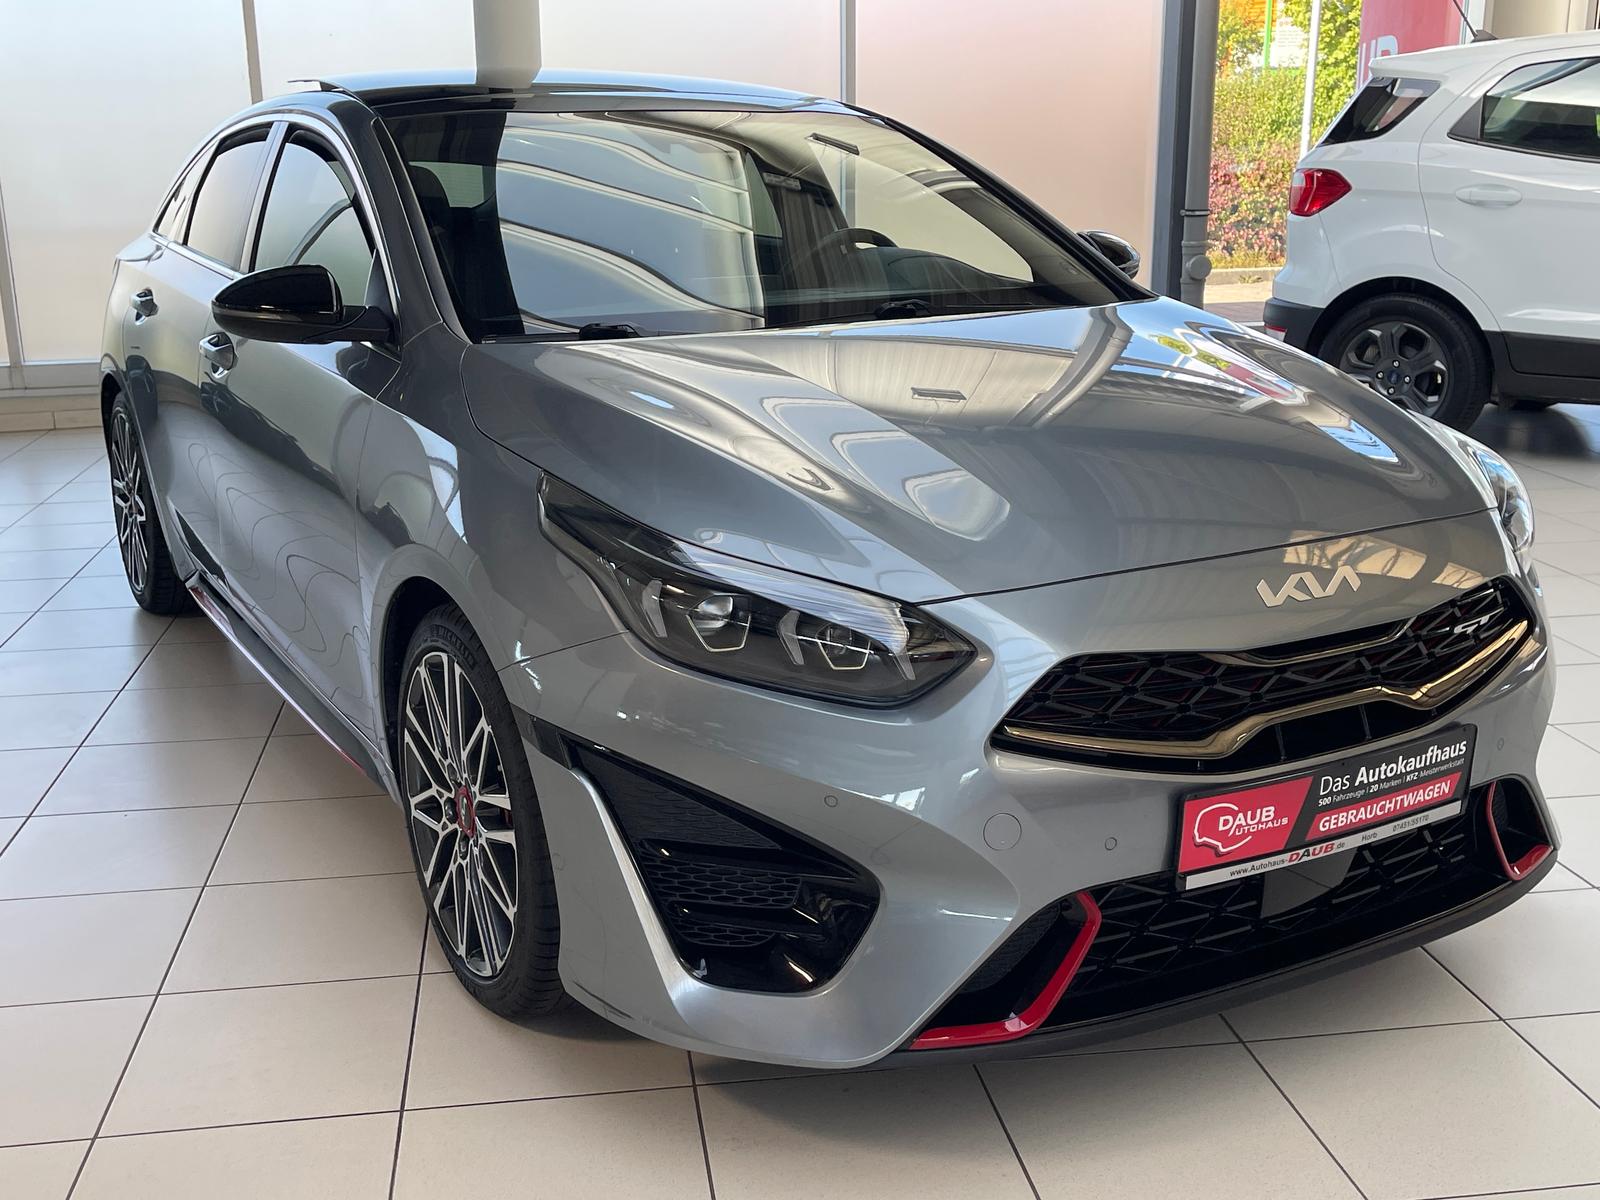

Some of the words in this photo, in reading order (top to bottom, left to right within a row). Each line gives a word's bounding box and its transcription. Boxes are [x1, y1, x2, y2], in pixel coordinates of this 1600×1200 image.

[1256, 565, 1362, 608] KIA
[1319, 775, 1350, 796] Das
[1354, 740, 1467, 787] Autokaufhaus
[1318, 796, 1332, 807] 500
[1332, 788, 1366, 803] Fahrzeuge
[1369, 784, 1379, 793] 20
[1380, 778, 1402, 791] Marken
[1319, 780, 1451, 832] GEBRAUCHTWAGEN
[1218, 806, 1276, 837] DAUB
[1361, 832, 1378, 842] Horb
